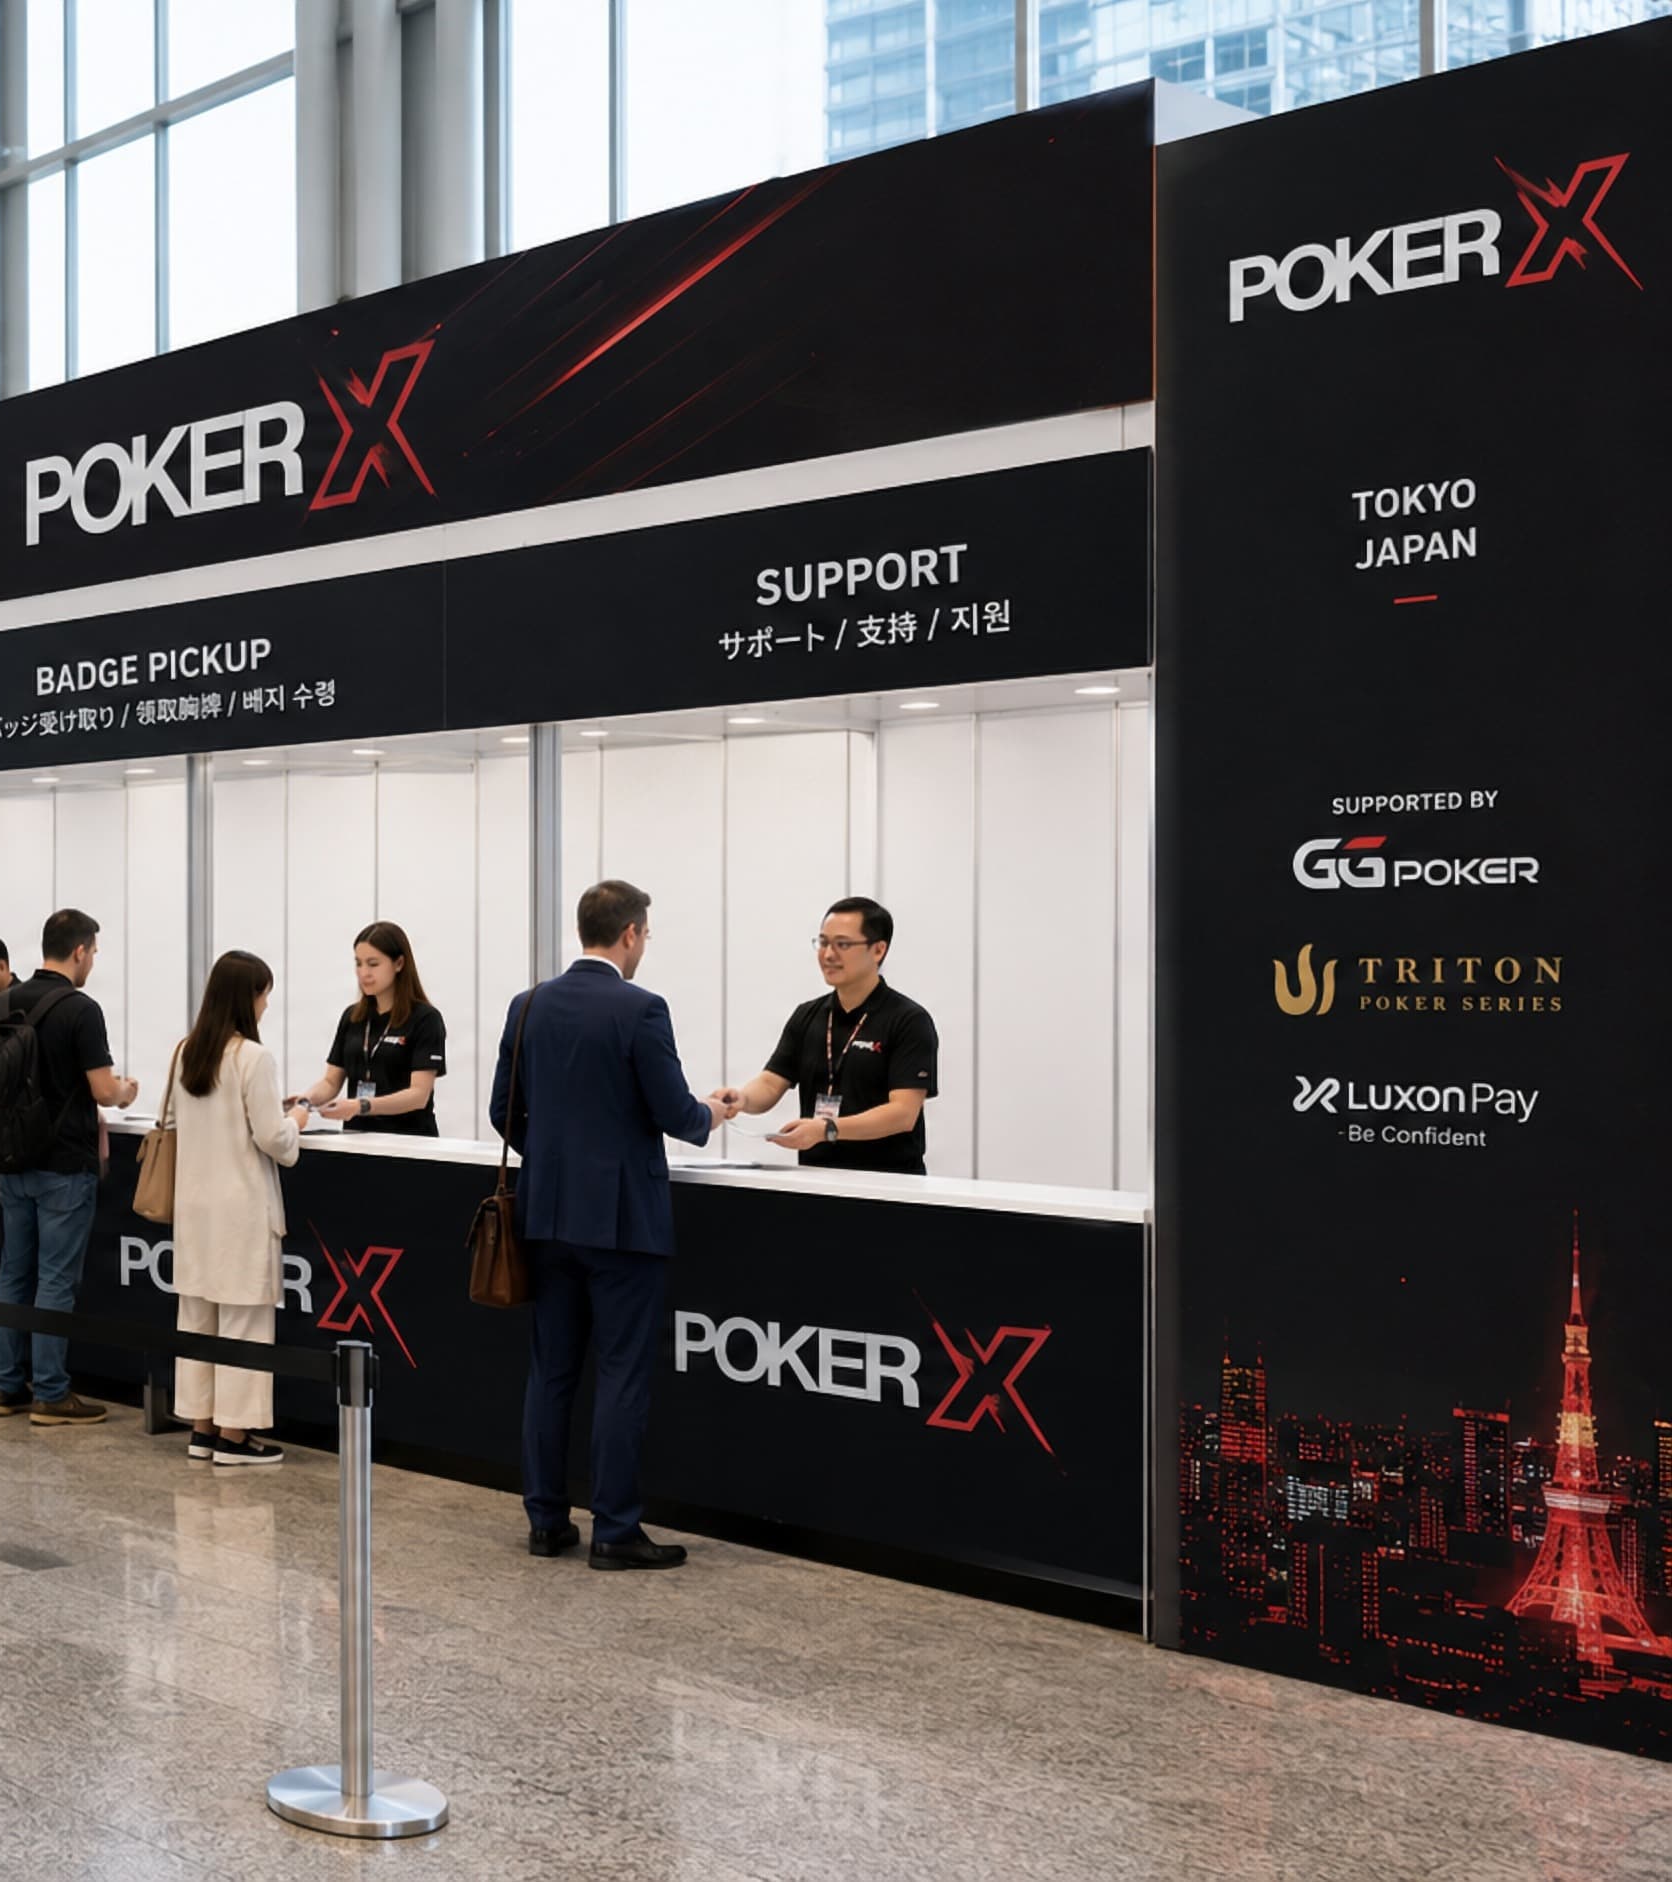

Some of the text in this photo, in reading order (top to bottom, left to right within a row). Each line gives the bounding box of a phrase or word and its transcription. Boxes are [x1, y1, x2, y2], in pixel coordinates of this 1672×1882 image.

[1351, 478, 1477, 521] TOKYO
[1354, 527, 1477, 570] JAPAN
[756, 543, 968, 606] SUPPORT
[718, 622, 825, 660] サポート
[857, 611, 918, 648] 支持
[951, 599, 1010, 636] 지원
[36, 638, 272, 697] BADGE PICKUP
[292, 679, 335, 709] 수령
[1332, 790, 1499, 815] SUPPORTED BY
[1358, 956, 1563, 986] TRITON
[1359, 995, 1563, 1013] POKER SERIES
[1381, 1125, 1487, 1147] Confident
